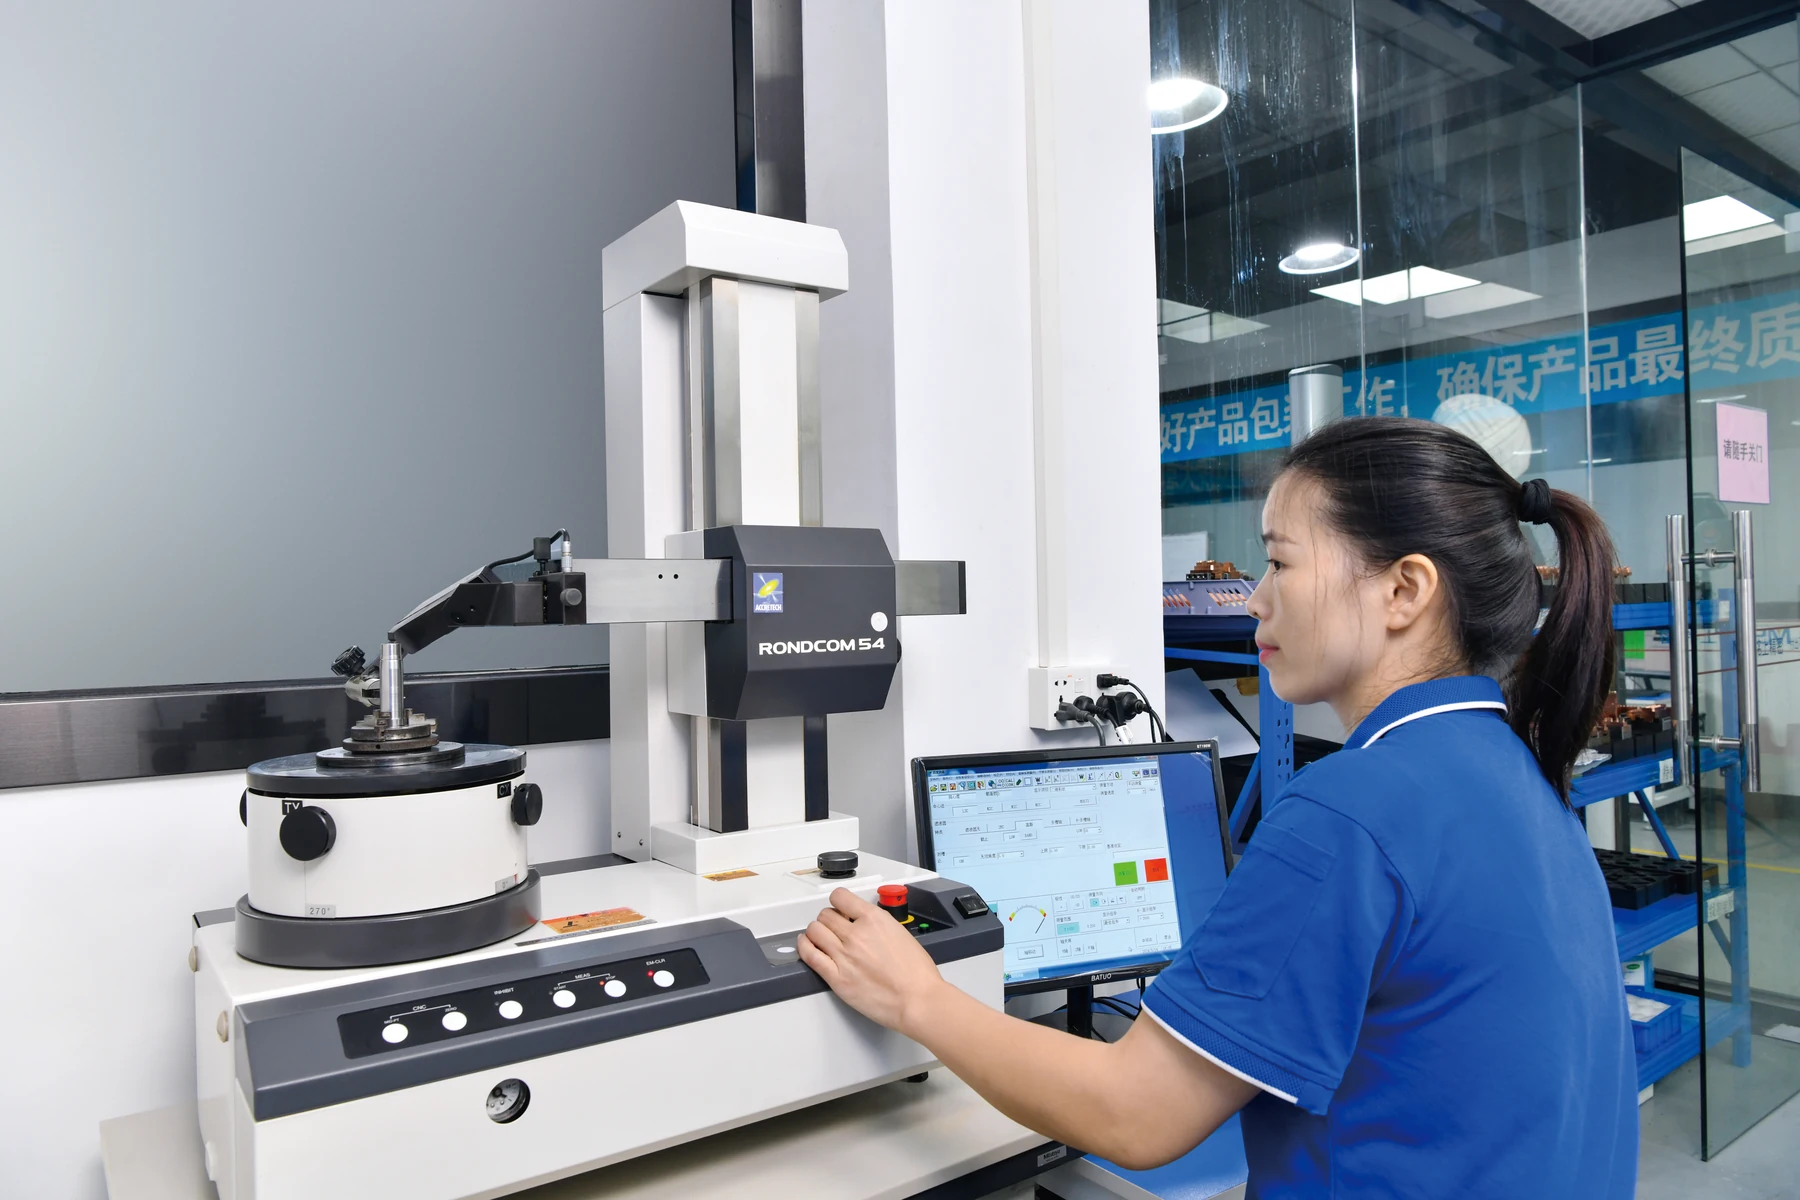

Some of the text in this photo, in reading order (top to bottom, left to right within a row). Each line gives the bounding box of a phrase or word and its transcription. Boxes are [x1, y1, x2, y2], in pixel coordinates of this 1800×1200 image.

[755, 603, 782, 611] ACCRETECH
[759, 637, 886, 655] RONDCOM 54
[499, 784, 511, 796] CX
[310, 906, 331, 916] 270°
[646, 958, 666, 966] EM-CLR
[1091, 973, 1112, 982] BATUO
[494, 987, 515, 995] INHIBIT
